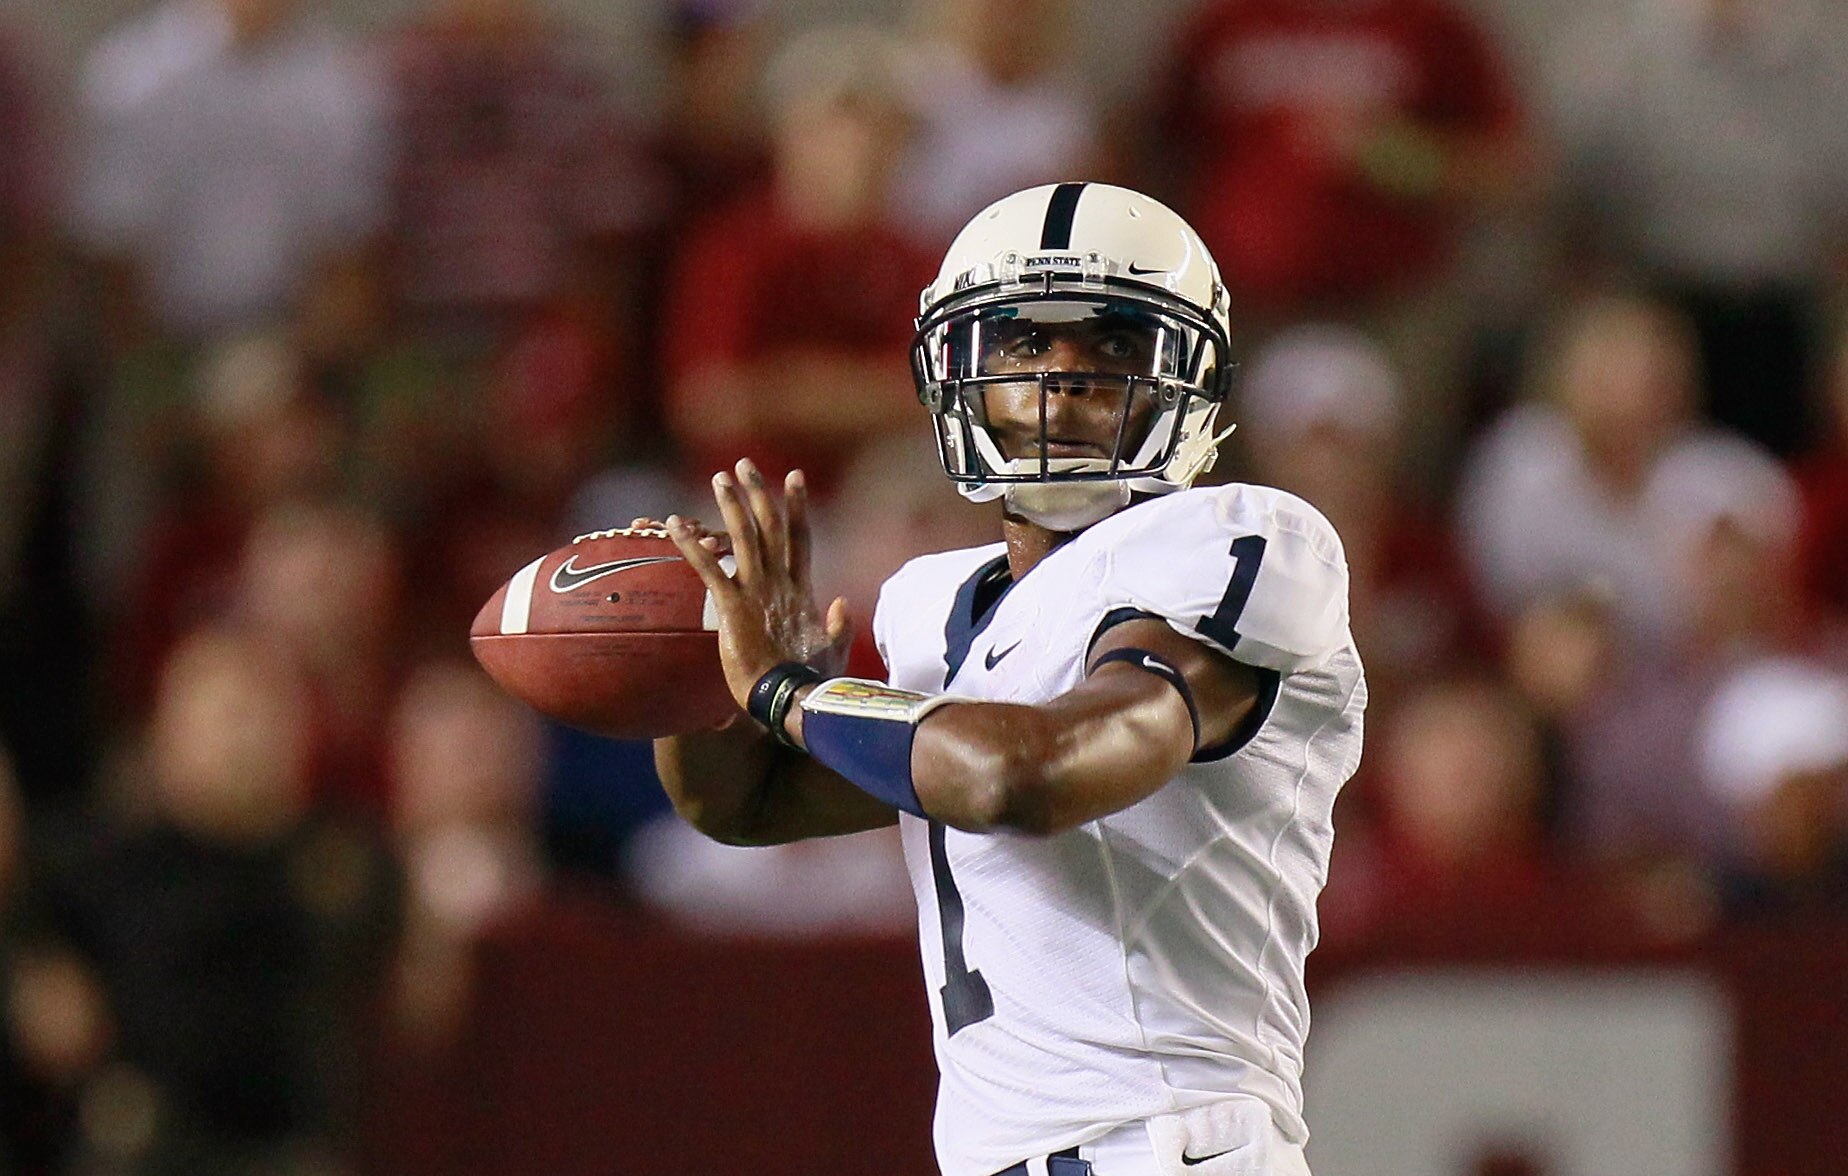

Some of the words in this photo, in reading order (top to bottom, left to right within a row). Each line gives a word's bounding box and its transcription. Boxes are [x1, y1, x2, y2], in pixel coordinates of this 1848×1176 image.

[1026, 257, 1051, 267] PENN
[1052, 256, 1081, 267] STATE
[1194, 534, 1268, 652] 1
[929, 819, 995, 1039] 1
